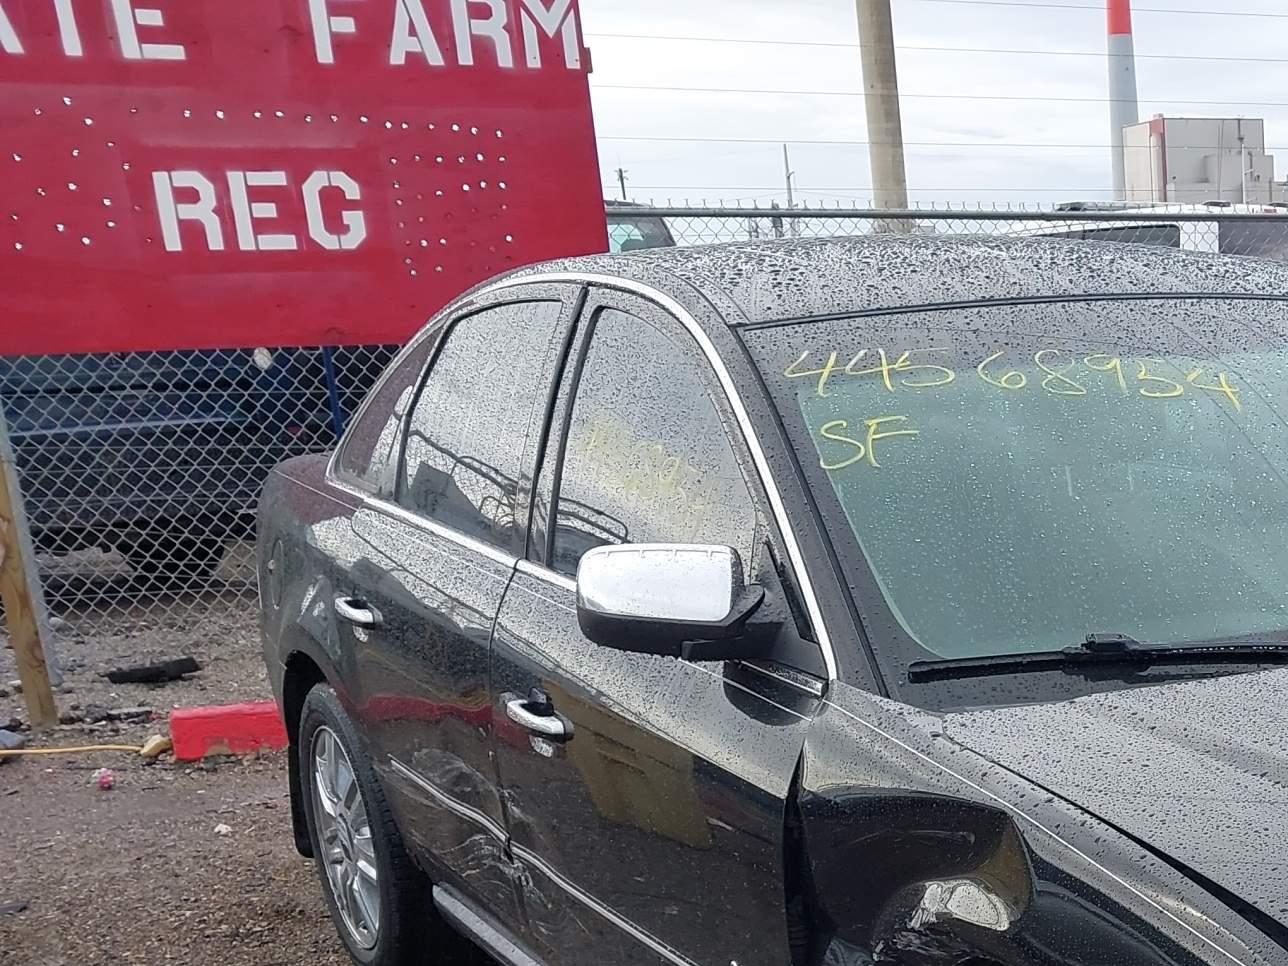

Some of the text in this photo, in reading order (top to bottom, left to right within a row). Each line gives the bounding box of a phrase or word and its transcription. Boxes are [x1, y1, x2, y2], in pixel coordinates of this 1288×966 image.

[308, 0, 582, 69] FARM
[152, 170, 367, 252] REG
[820, 415, 920, 469] SF
